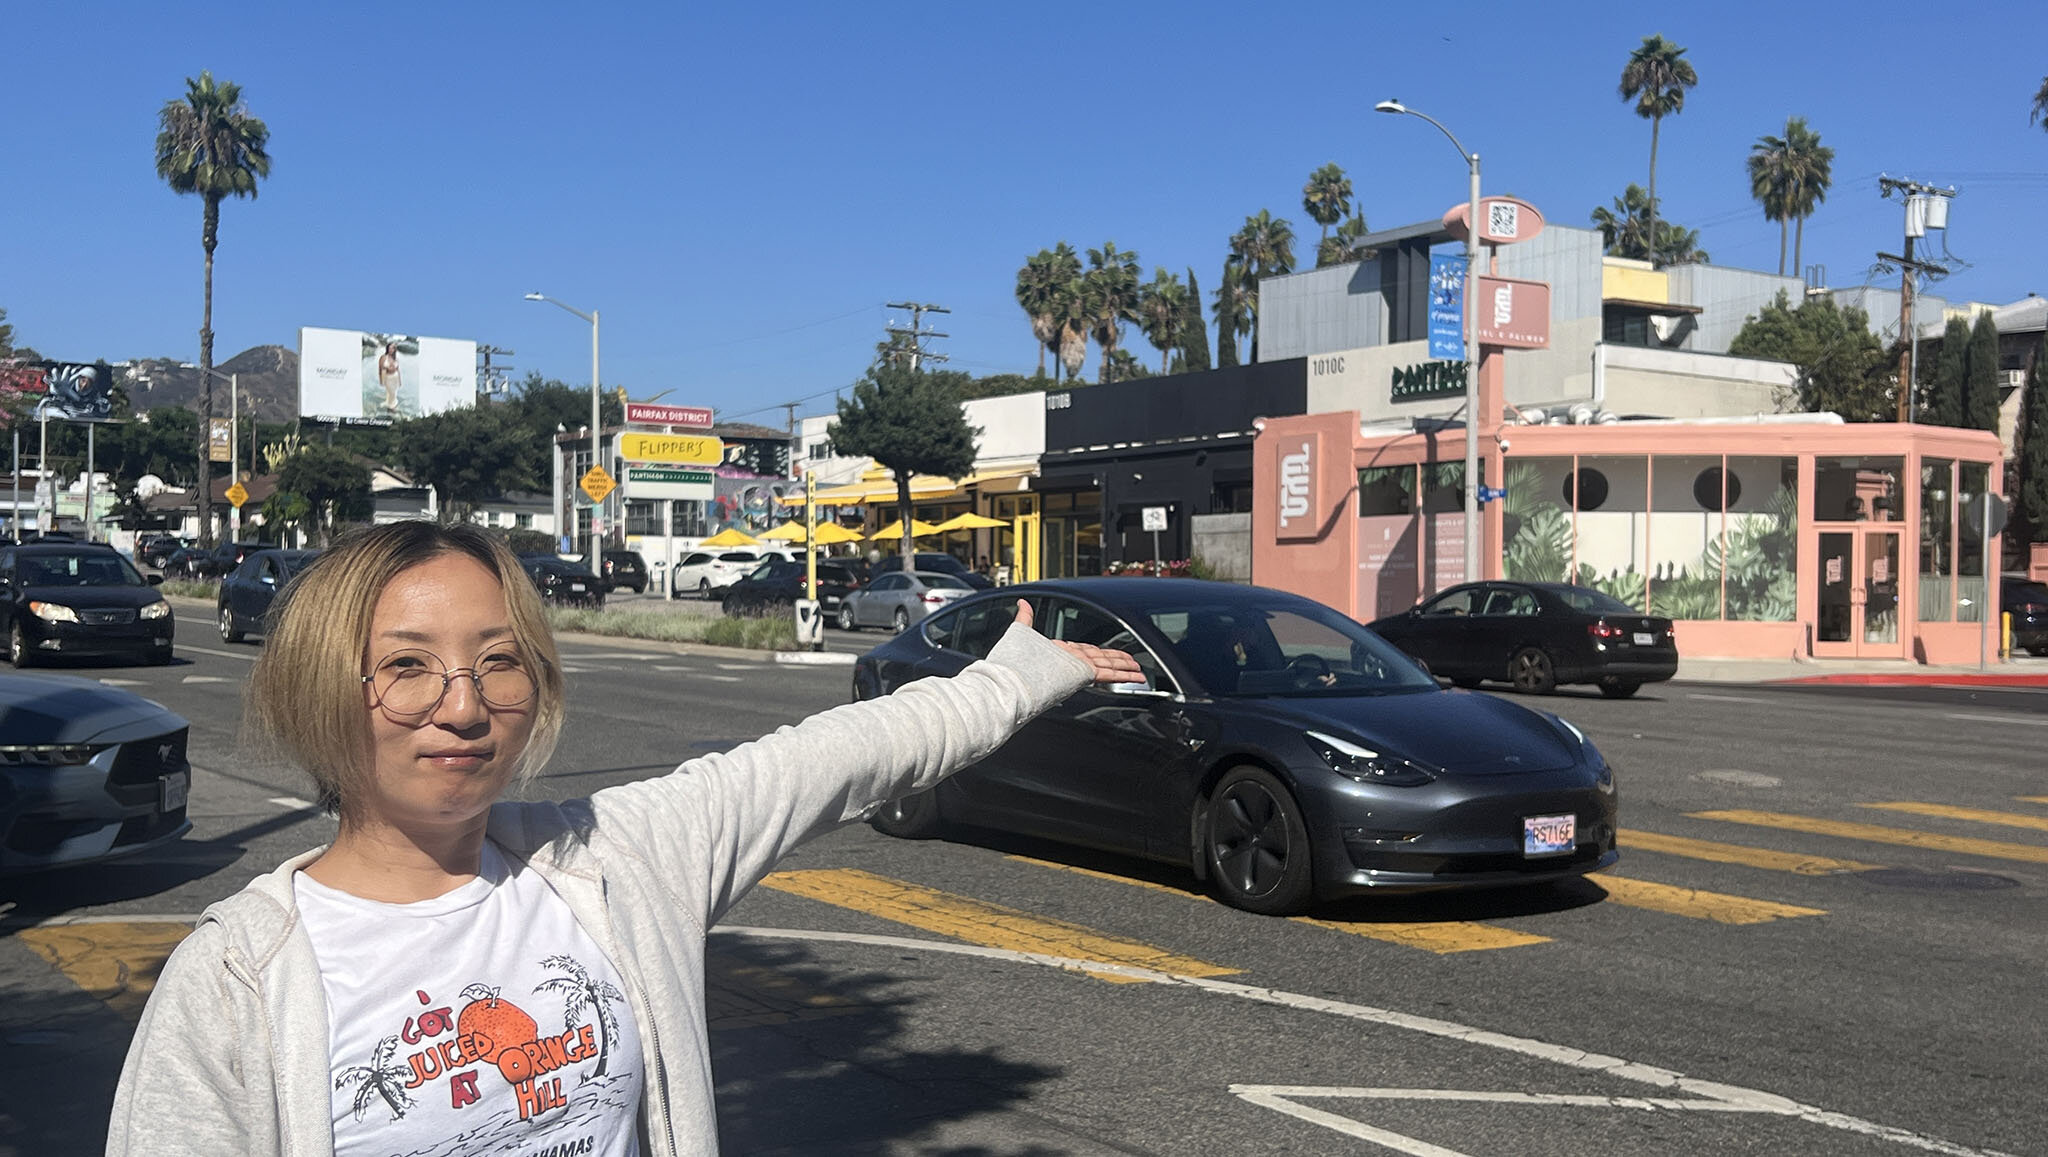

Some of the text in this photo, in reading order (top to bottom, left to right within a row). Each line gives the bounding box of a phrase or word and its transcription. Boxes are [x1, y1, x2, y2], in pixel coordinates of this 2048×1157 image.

[1313, 357, 1345, 376] 1010C
[1392, 382, 1440, 396] COFFEE
[632, 408, 708, 423] FAIRFAX DISTRICT
[639, 440, 705, 458] FLIPPER'S
[402, 1007, 454, 1045] GOT
[405, 1024, 599, 1089] JUICED ORANGE
[450, 1069, 482, 1109] AT
[514, 1078, 567, 1120] HILL
[526, 1135, 594, 1157] HAMAS
